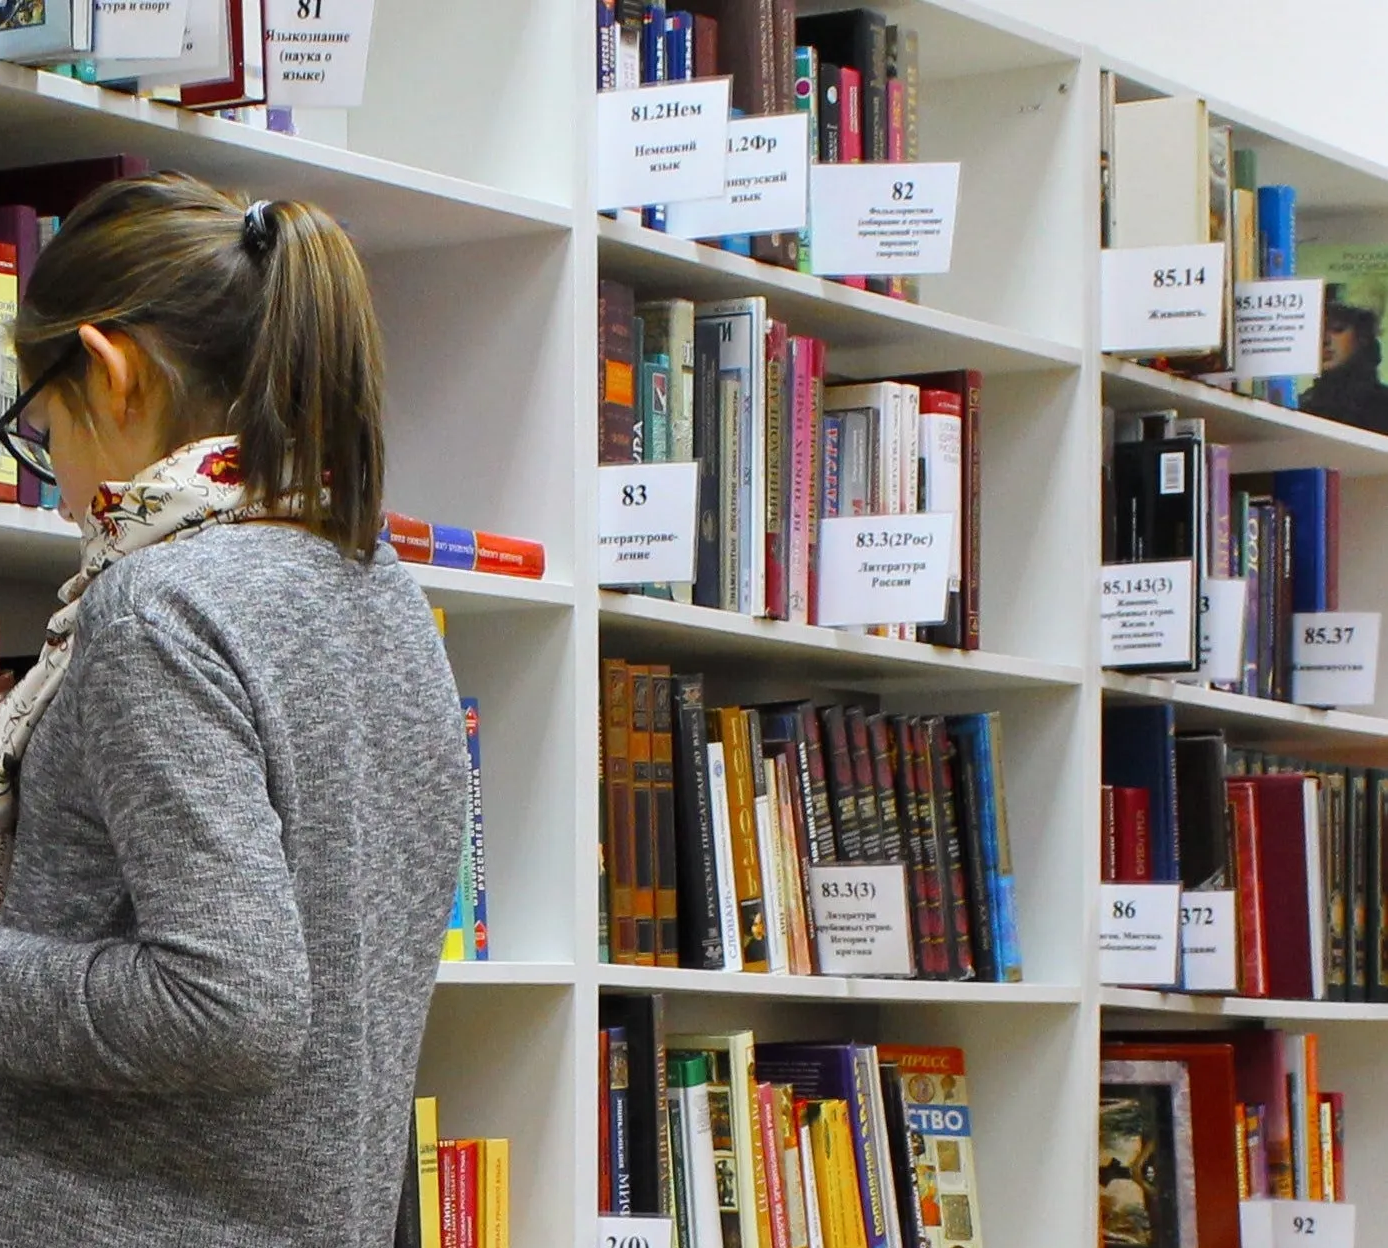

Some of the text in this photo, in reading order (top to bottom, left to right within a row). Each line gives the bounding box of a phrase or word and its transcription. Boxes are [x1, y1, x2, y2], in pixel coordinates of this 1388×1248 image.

[94, 0, 170, 15] ьтура и спорт
[295, 0, 323, 21] 81
[265, 28, 349, 45] Языкознание
[280, 49, 332, 65] (наука о
[283, 66, 326, 84] языке)
[630, 101, 702, 123] 81.2Нем
[635, 140, 697, 158] Немецкий
[726, 134, 777, 155] 1.2Фр
[650, 159, 681, 173] язык
[728, 171, 788, 189] нцузский
[731, 191, 762, 204] язык
[891, 182, 914, 200] 82
[1153, 266, 1205, 289] 85.14
[621, 484, 648, 506] 83
[598, 532, 678, 546] итературове-
[856, 532, 934, 549] 83.3(2Рос)
[616, 548, 650, 562] дение
[858, 561, 926, 574] Литература
[871, 576, 912, 589] России
[1103, 577, 1172, 595] 85.143(3)
[1304, 627, 1354, 645] 85.37
[821, 880, 877, 900] 83.3(3)
[1112, 901, 1136, 920] 86
[1180, 907, 1214, 926] 372
[907, 1108, 963, 1131] СТВО
[1293, 1218, 1314, 1234] 92
